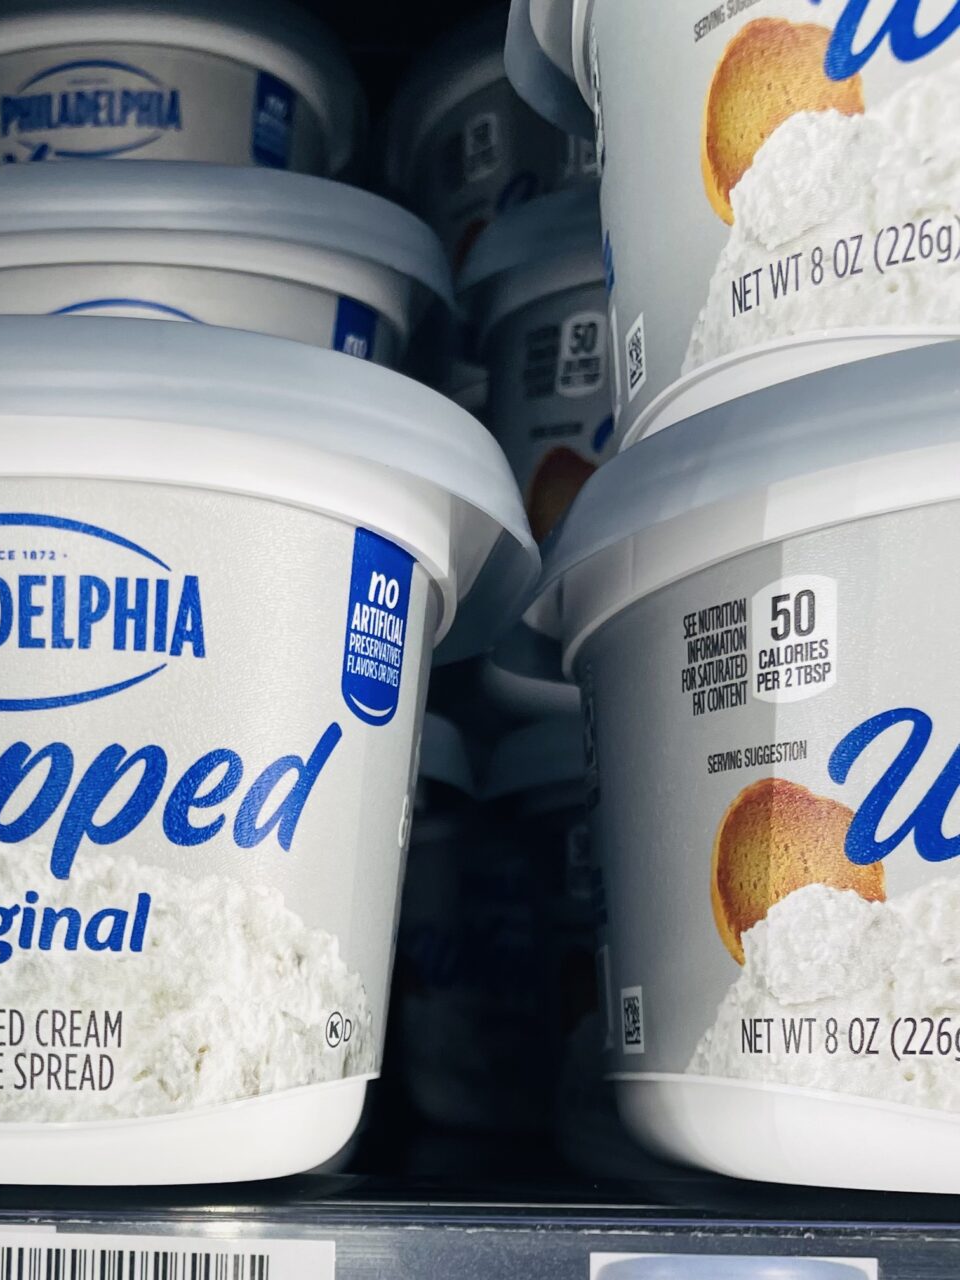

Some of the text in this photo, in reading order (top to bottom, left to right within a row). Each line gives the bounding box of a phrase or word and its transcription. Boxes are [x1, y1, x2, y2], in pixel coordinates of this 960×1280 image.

[731, 267, 762, 318] NET
[769, 252, 803, 300] WT
[811, 246, 824, 286] 8
[833, 234, 864, 279] OZ
[22, 551, 56, 560] 1872
[368, 571, 399, 609] no
[351, 602, 403, 646] ARTIFICIAL
[683, 598, 746, 639] SEE NUTRITION
[771, 589, 815, 641] 50
[349, 633, 401, 667] PRESERVATIVES
[688, 625, 747, 664] INFORMATION
[759, 639, 828, 669] CALORIES
[682, 654, 747, 693] FOR SATURATED
[757, 662, 831, 692] PER 2 TBSP
[693, 681, 748, 716] FAT CONTENT
[707, 740, 807, 774] SERVING SUGGESTION
[35, 1010, 123, 1048] CREAM
[741, 1018, 774, 1054] NET
[782, 1018, 817, 1054] WT
[825, 1017, 838, 1053] 8
[848, 1017, 880, 1055] OZ
[13, 1053, 114, 1091] SPREAD
